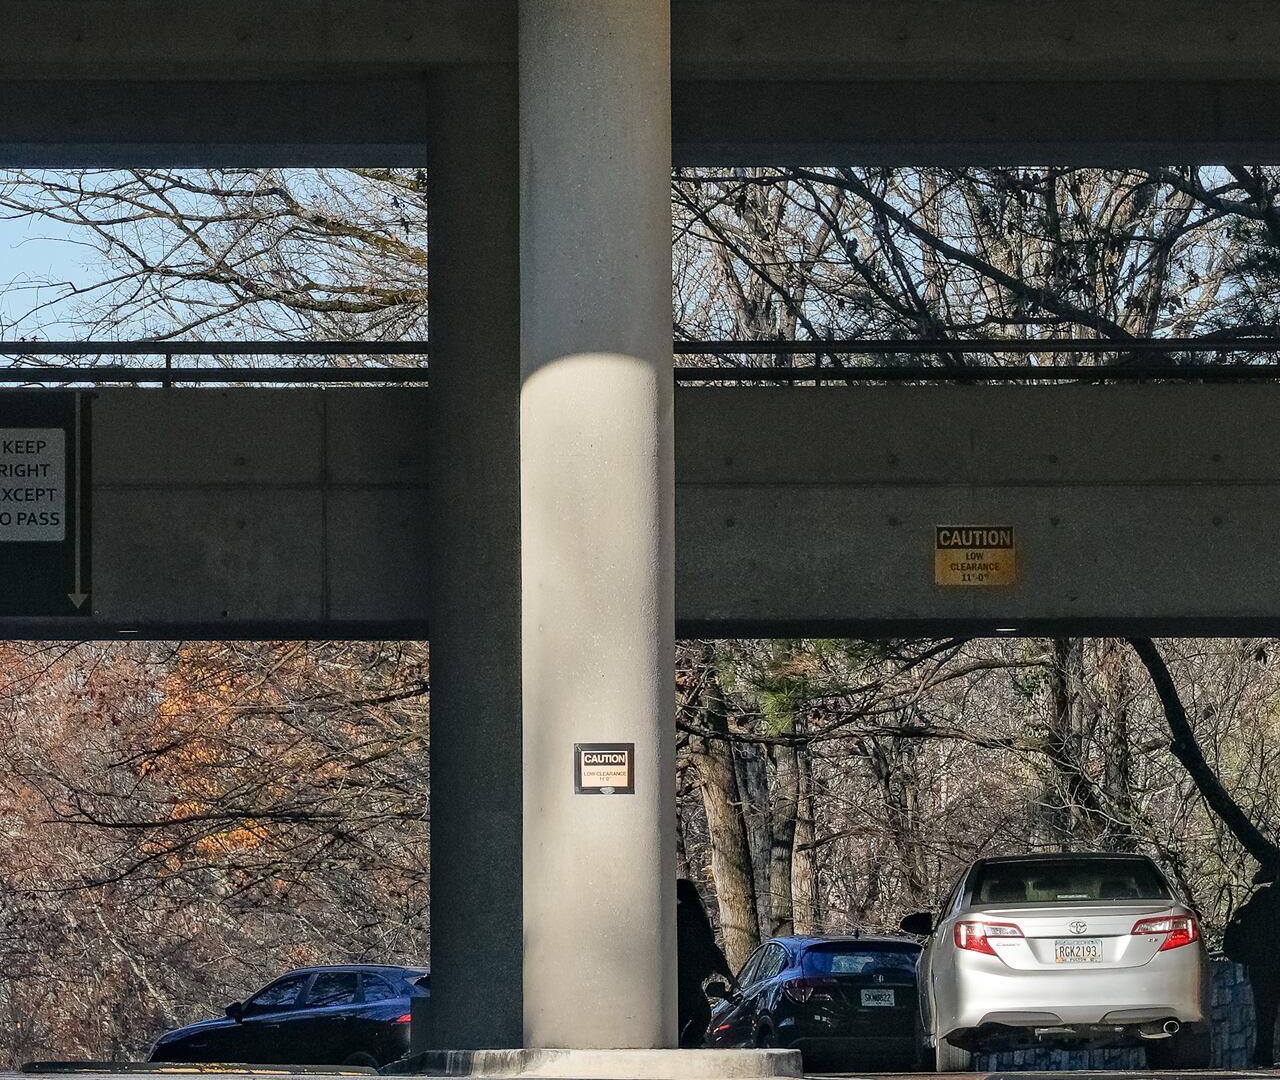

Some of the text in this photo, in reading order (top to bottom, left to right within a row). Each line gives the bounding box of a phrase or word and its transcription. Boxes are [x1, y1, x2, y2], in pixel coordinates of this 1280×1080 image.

[2, 440, 47, 454] KEEP
[17, 512, 60, 526] PASS
[940, 530, 1011, 546] CAUTION
[965, 551, 984, 561] LOW
[950, 562, 1001, 571] CLEARANCE
[584, 754, 625, 763] CAUTION
[1059, 945, 1097, 957] RGK2193
